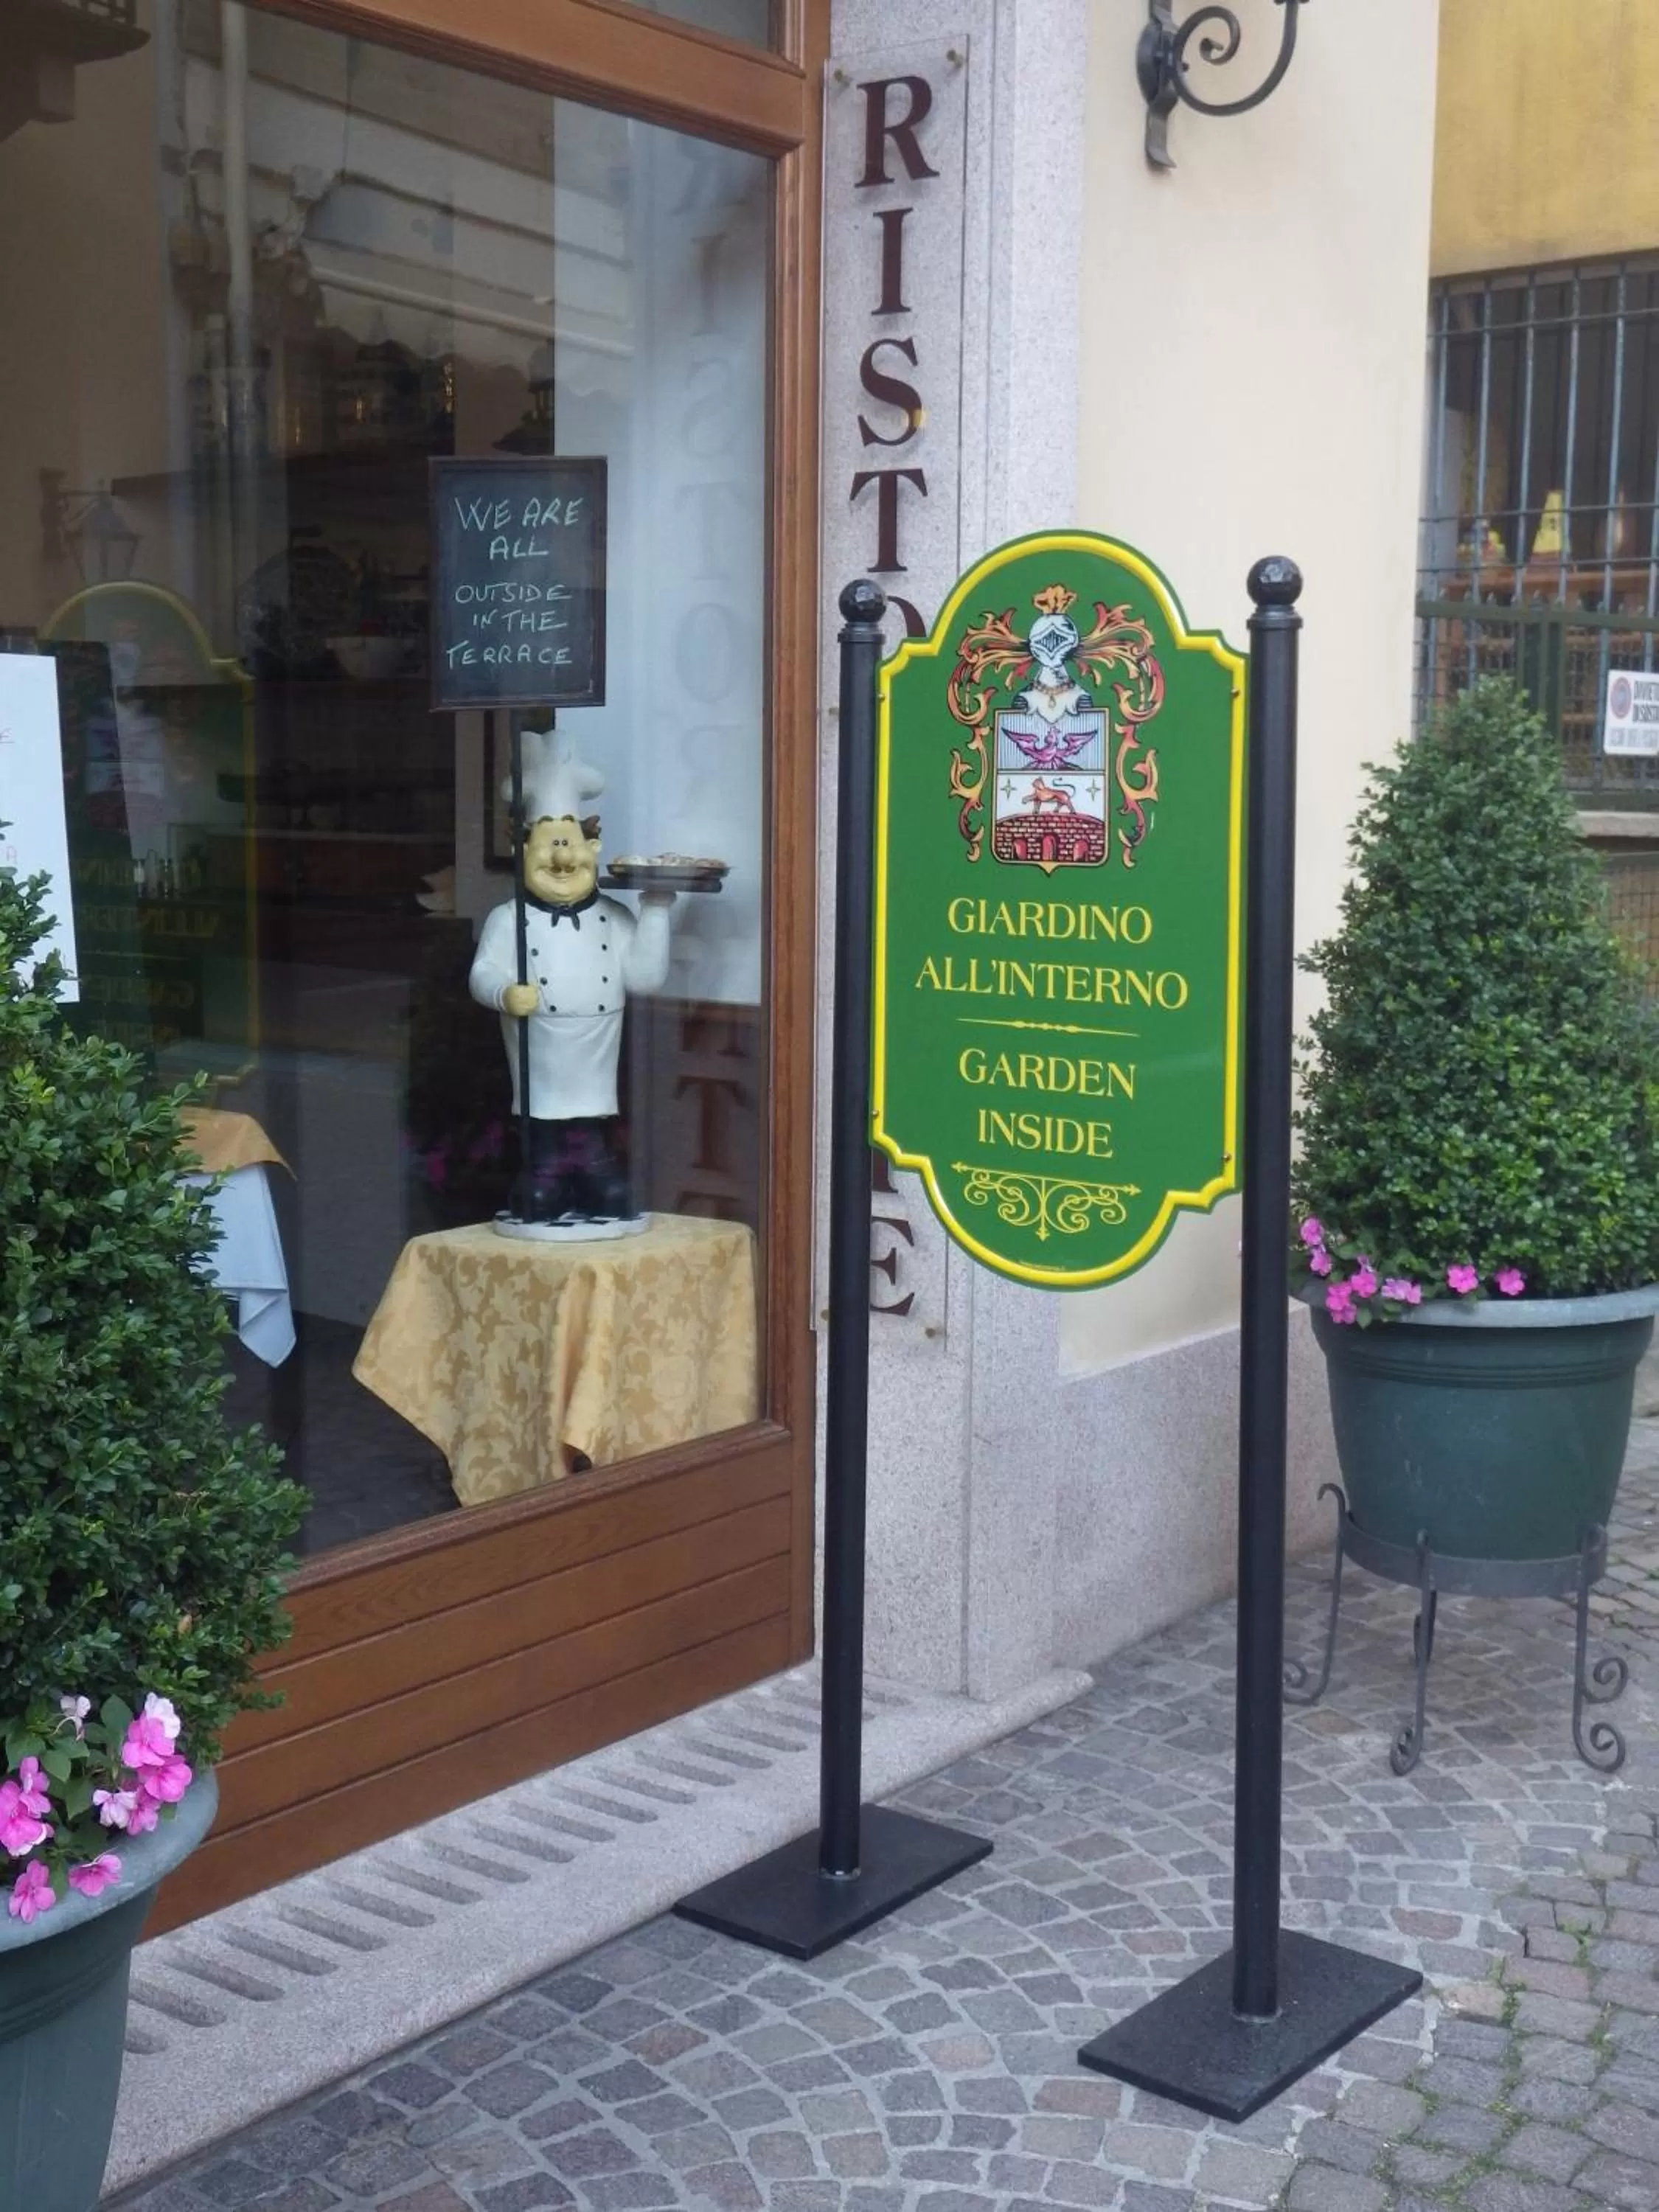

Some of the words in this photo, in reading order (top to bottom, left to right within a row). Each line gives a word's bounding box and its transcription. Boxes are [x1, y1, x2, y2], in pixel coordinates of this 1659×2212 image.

[454, 497, 511, 531] WE
[522, 497, 584, 528] ARE
[490, 535, 549, 560] ALL
[455, 582, 573, 604] OUTSIDE
[473, 608, 498, 629] IN
[501, 609, 569, 633] THE
[446, 639, 573, 670] TERRACE
[947, 897, 1153, 945] GIARDINO
[914, 956, 1189, 1010] ALL'INTERNO
[959, 1048, 1137, 1100] GARDEN
[978, 1108, 1114, 1158] INSIDE
